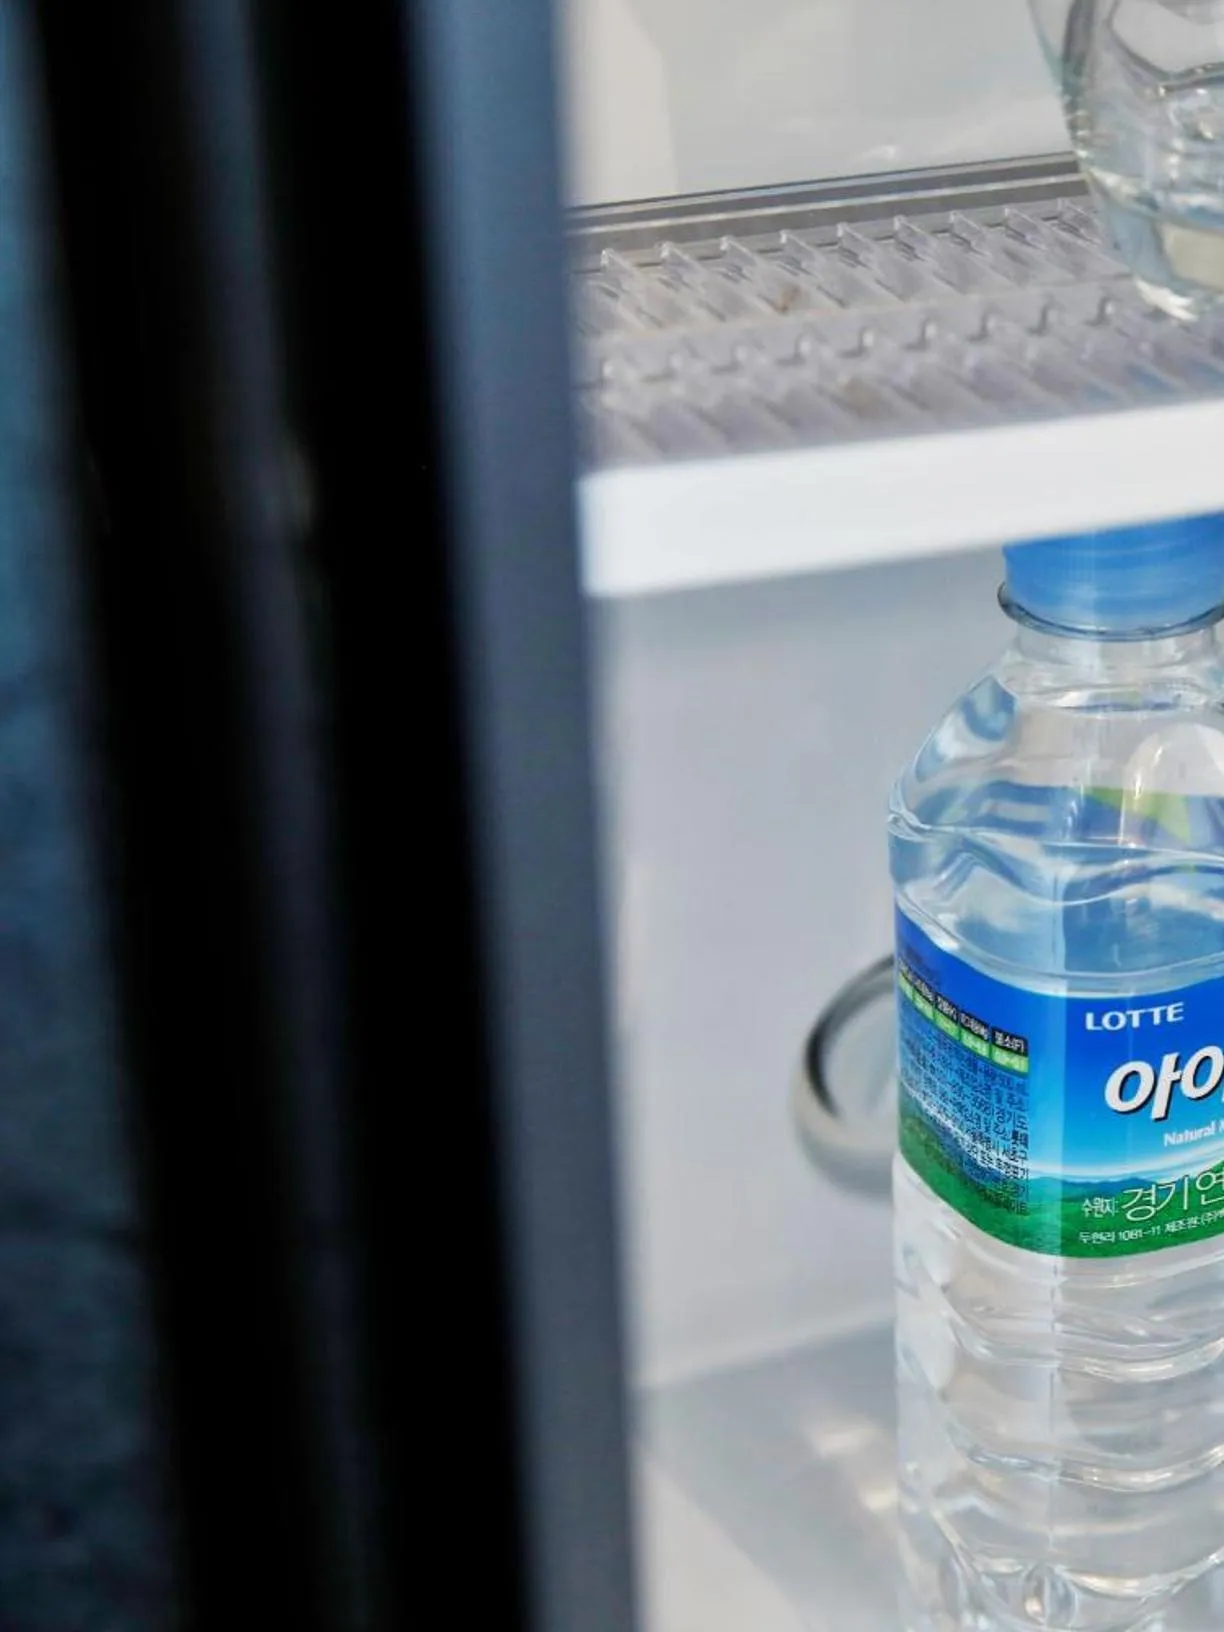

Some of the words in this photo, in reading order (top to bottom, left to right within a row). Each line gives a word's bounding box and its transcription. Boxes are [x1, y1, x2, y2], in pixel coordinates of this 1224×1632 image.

[1084, 1002, 1185, 1031] LOTTE
[1163, 1120, 1216, 1147] Natural
[1121, 1174, 1189, 1221] 경기
